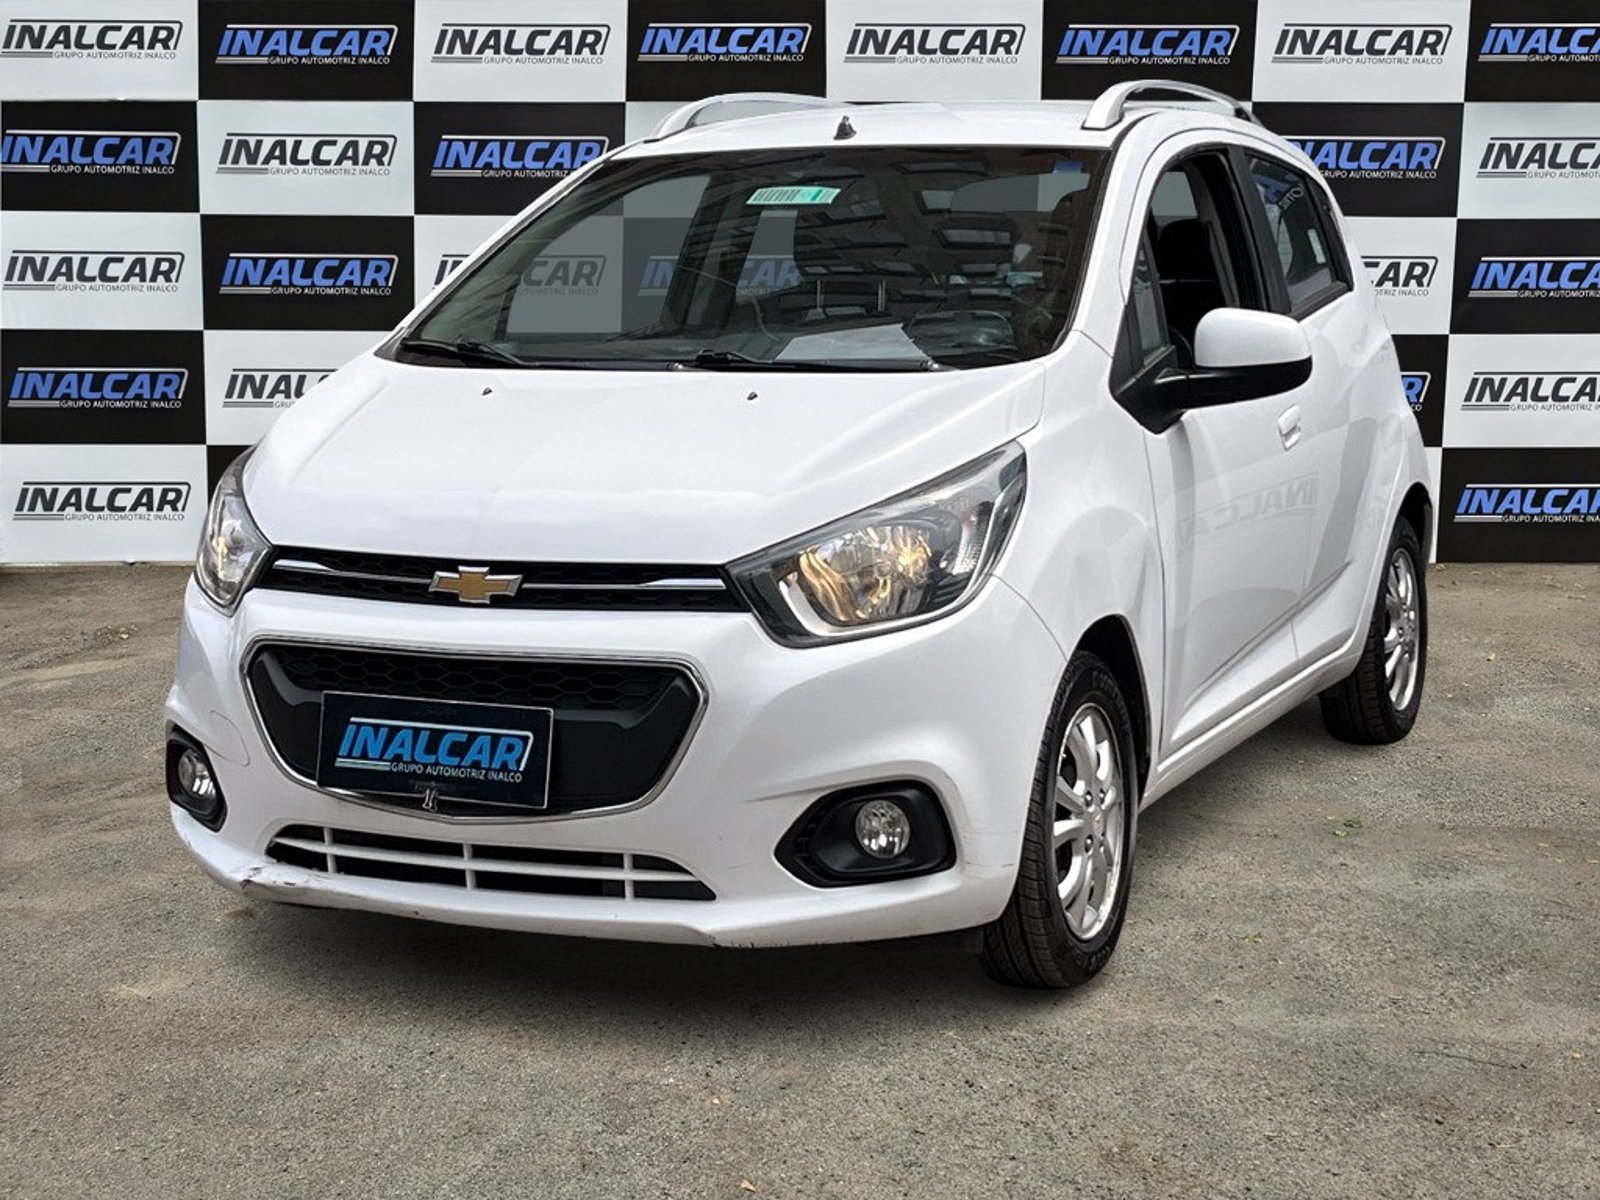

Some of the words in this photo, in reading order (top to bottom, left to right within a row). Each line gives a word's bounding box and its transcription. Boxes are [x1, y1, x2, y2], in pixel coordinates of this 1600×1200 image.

[3, 25, 175, 51] INALCAR
[218, 30, 388, 56] INALCAR
[434, 29, 601, 55] INALCAR
[640, 28, 803, 53] INALCAR
[847, 29, 1016, 55] INALCAR
[1056, 30, 1231, 56] INALCAR
[1274, 29, 1444, 56] INALCAR
[1481, 28, 1600, 54] INALC
[54, 51, 84, 59] GRUPO
[86, 51, 143, 60] AUTOMOTRIZ
[145, 52, 176, 60] INALCO
[269, 57, 299, 65] GRUPO
[301, 57, 356, 65] AUTOMOTRIZ
[358, 57, 390, 65] INALCO
[572, 57, 603, 65] INALCO
[689, 54, 716, 62] GRUPO
[718, 54, 772, 62] AUTOMOTRIZ
[774, 54, 804, 62] INALCO
[929, 56, 984, 64] AUTOMOTRIZ
[1109, 57, 1139, 65] GRUPO
[1141, 57, 1197, 65] AUTOMOTRIZ
[1199, 57, 1231, 65] INALCO
[1324, 57, 1353, 65] GRUPO
[1355, 57, 1409, 65] AUTOMOTRIZ
[1412, 57, 1443, 65] INALCO
[1527, 54, 1557, 62] GRUPO
[1560, 54, 1600, 62] AUTOMOT
[0, 136, 173, 165] INALCAR
[219, 139, 390, 166] INALCAR
[433, 140, 601, 169] INALCAR
[1298, 141, 1437, 170] ALCAR
[1479, 143, 1600, 169] INALC
[51, 165, 81, 173] GRUPO
[84, 165, 140, 174] AUTOMOTRIZ
[270, 167, 299, 175] GRUPO
[301, 167, 357, 175] AUTOMOTRIZ
[358, 168, 390, 176] INALCO
[483, 170, 511, 178] GRUPO
[514, 170, 568, 178] AUTOMOTRIZ
[1349, 171, 1403, 179] AUTOMOTRIZ
[1406, 171, 1436, 179] INALCO
[5, 256, 177, 283] INALCAR
[222, 259, 392, 286] INALCAR
[1471, 262, 1600, 289] INALCA
[56, 284, 86, 292] GRUPO
[89, 284, 144, 292] AUTOMOTRIZ
[272, 287, 302, 295] GRUPO
[304, 287, 358, 295] AUTOMOTRIZ
[361, 288, 391, 296] INALCO
[1398, 289, 1429, 297] INALCO
[1518, 290, 1547, 298] GRUPO
[10, 373, 182, 400] INALCAR
[225, 374, 329, 399] INAL
[1463, 377, 1600, 402] INALCA
[61, 400, 91, 409] GRUPO
[93, 400, 149, 409] AUTOMOTRIZ
[151, 401, 181, 409] INALCO
[1510, 403, 1538, 411] GRUPO
[1541, 403, 1592, 411] AUTOMOTRIZ
[15, 487, 184, 512] INALCAR
[65, 513, 95, 521] GRUPO
[97, 513, 152, 521] AUTOMOTRIZ
[154, 513, 185, 521] INALCO
[1503, 514, 1531, 522] GRUPO
[1533, 514, 1584, 522] AUTOMOTRIZ
[339, 725, 524, 770] INALCAR
[391, 763, 423, 774] GRUPO
[425, 766, 486, 779] AUTOMOTRIZ
[487, 772, 523, 783] INALCO
